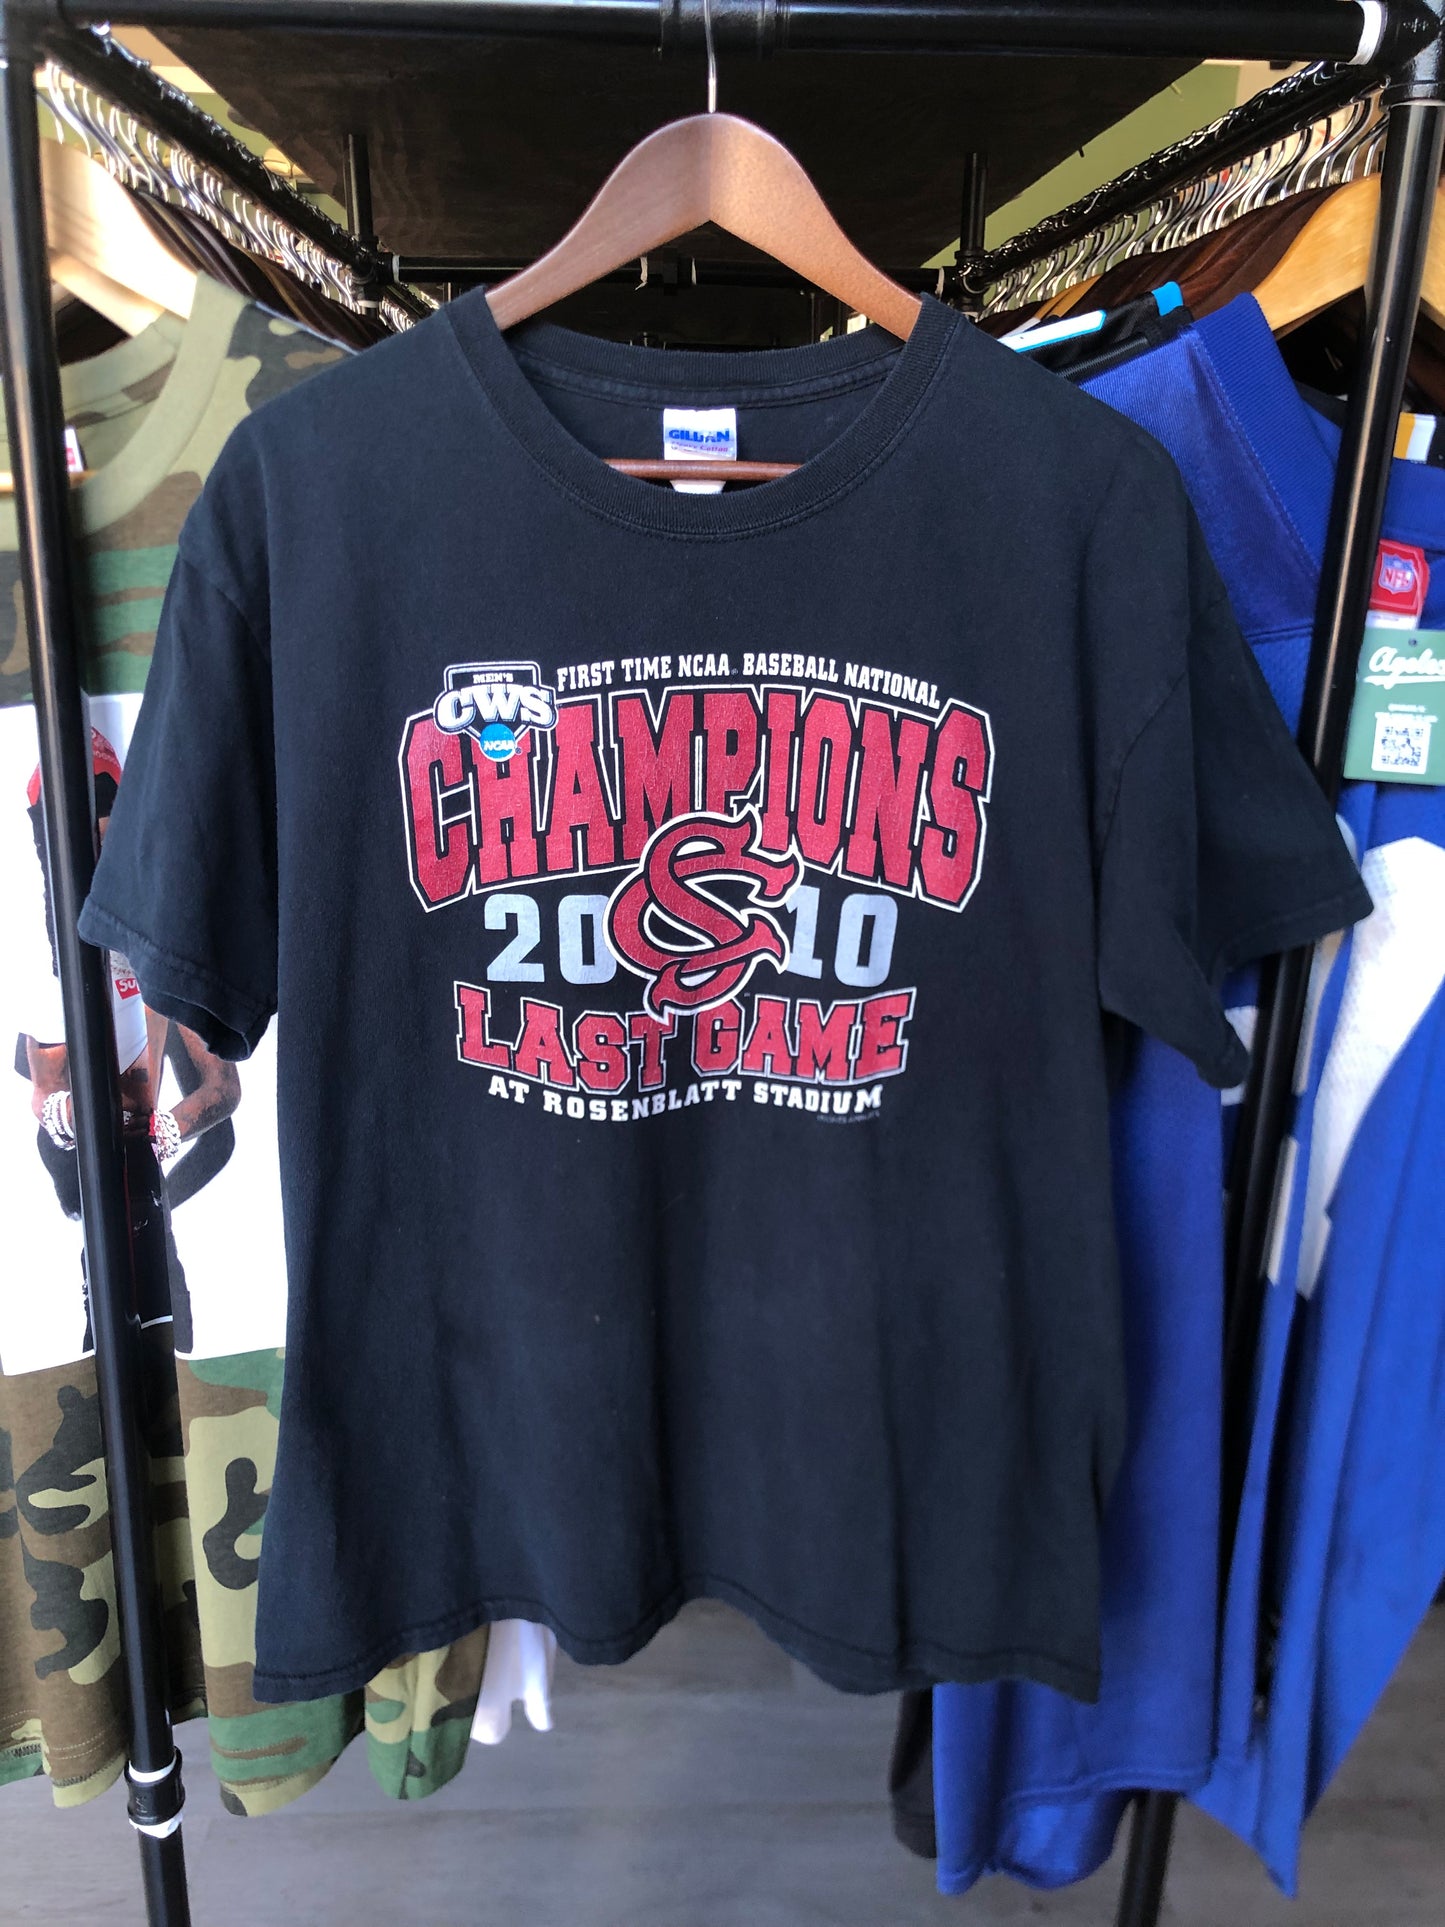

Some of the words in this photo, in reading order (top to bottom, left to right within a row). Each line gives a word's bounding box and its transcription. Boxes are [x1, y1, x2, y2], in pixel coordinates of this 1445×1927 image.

[1383, 567, 1411, 588] NFL
[472, 672, 514, 684] MEN'S
[557, 661, 615, 692] FIRST
[621, 656, 672, 682] TIME
[678, 653, 730, 677] NCAA
[742, 653, 839, 683] BASEBALL
[844, 663, 940, 709] NATIONAL
[436, 682, 554, 729] CWS
[483, 739, 515, 752] NCAA
[399, 683, 995, 913] CHAMPIONS
[454, 981, 678, 1095] LAST
[691, 986, 917, 1085] GAME
[488, 1076, 530, 1105] AT
[543, 1080, 742, 1122] ROSENBLATT
[754, 1083, 883, 1115] STADIUM
